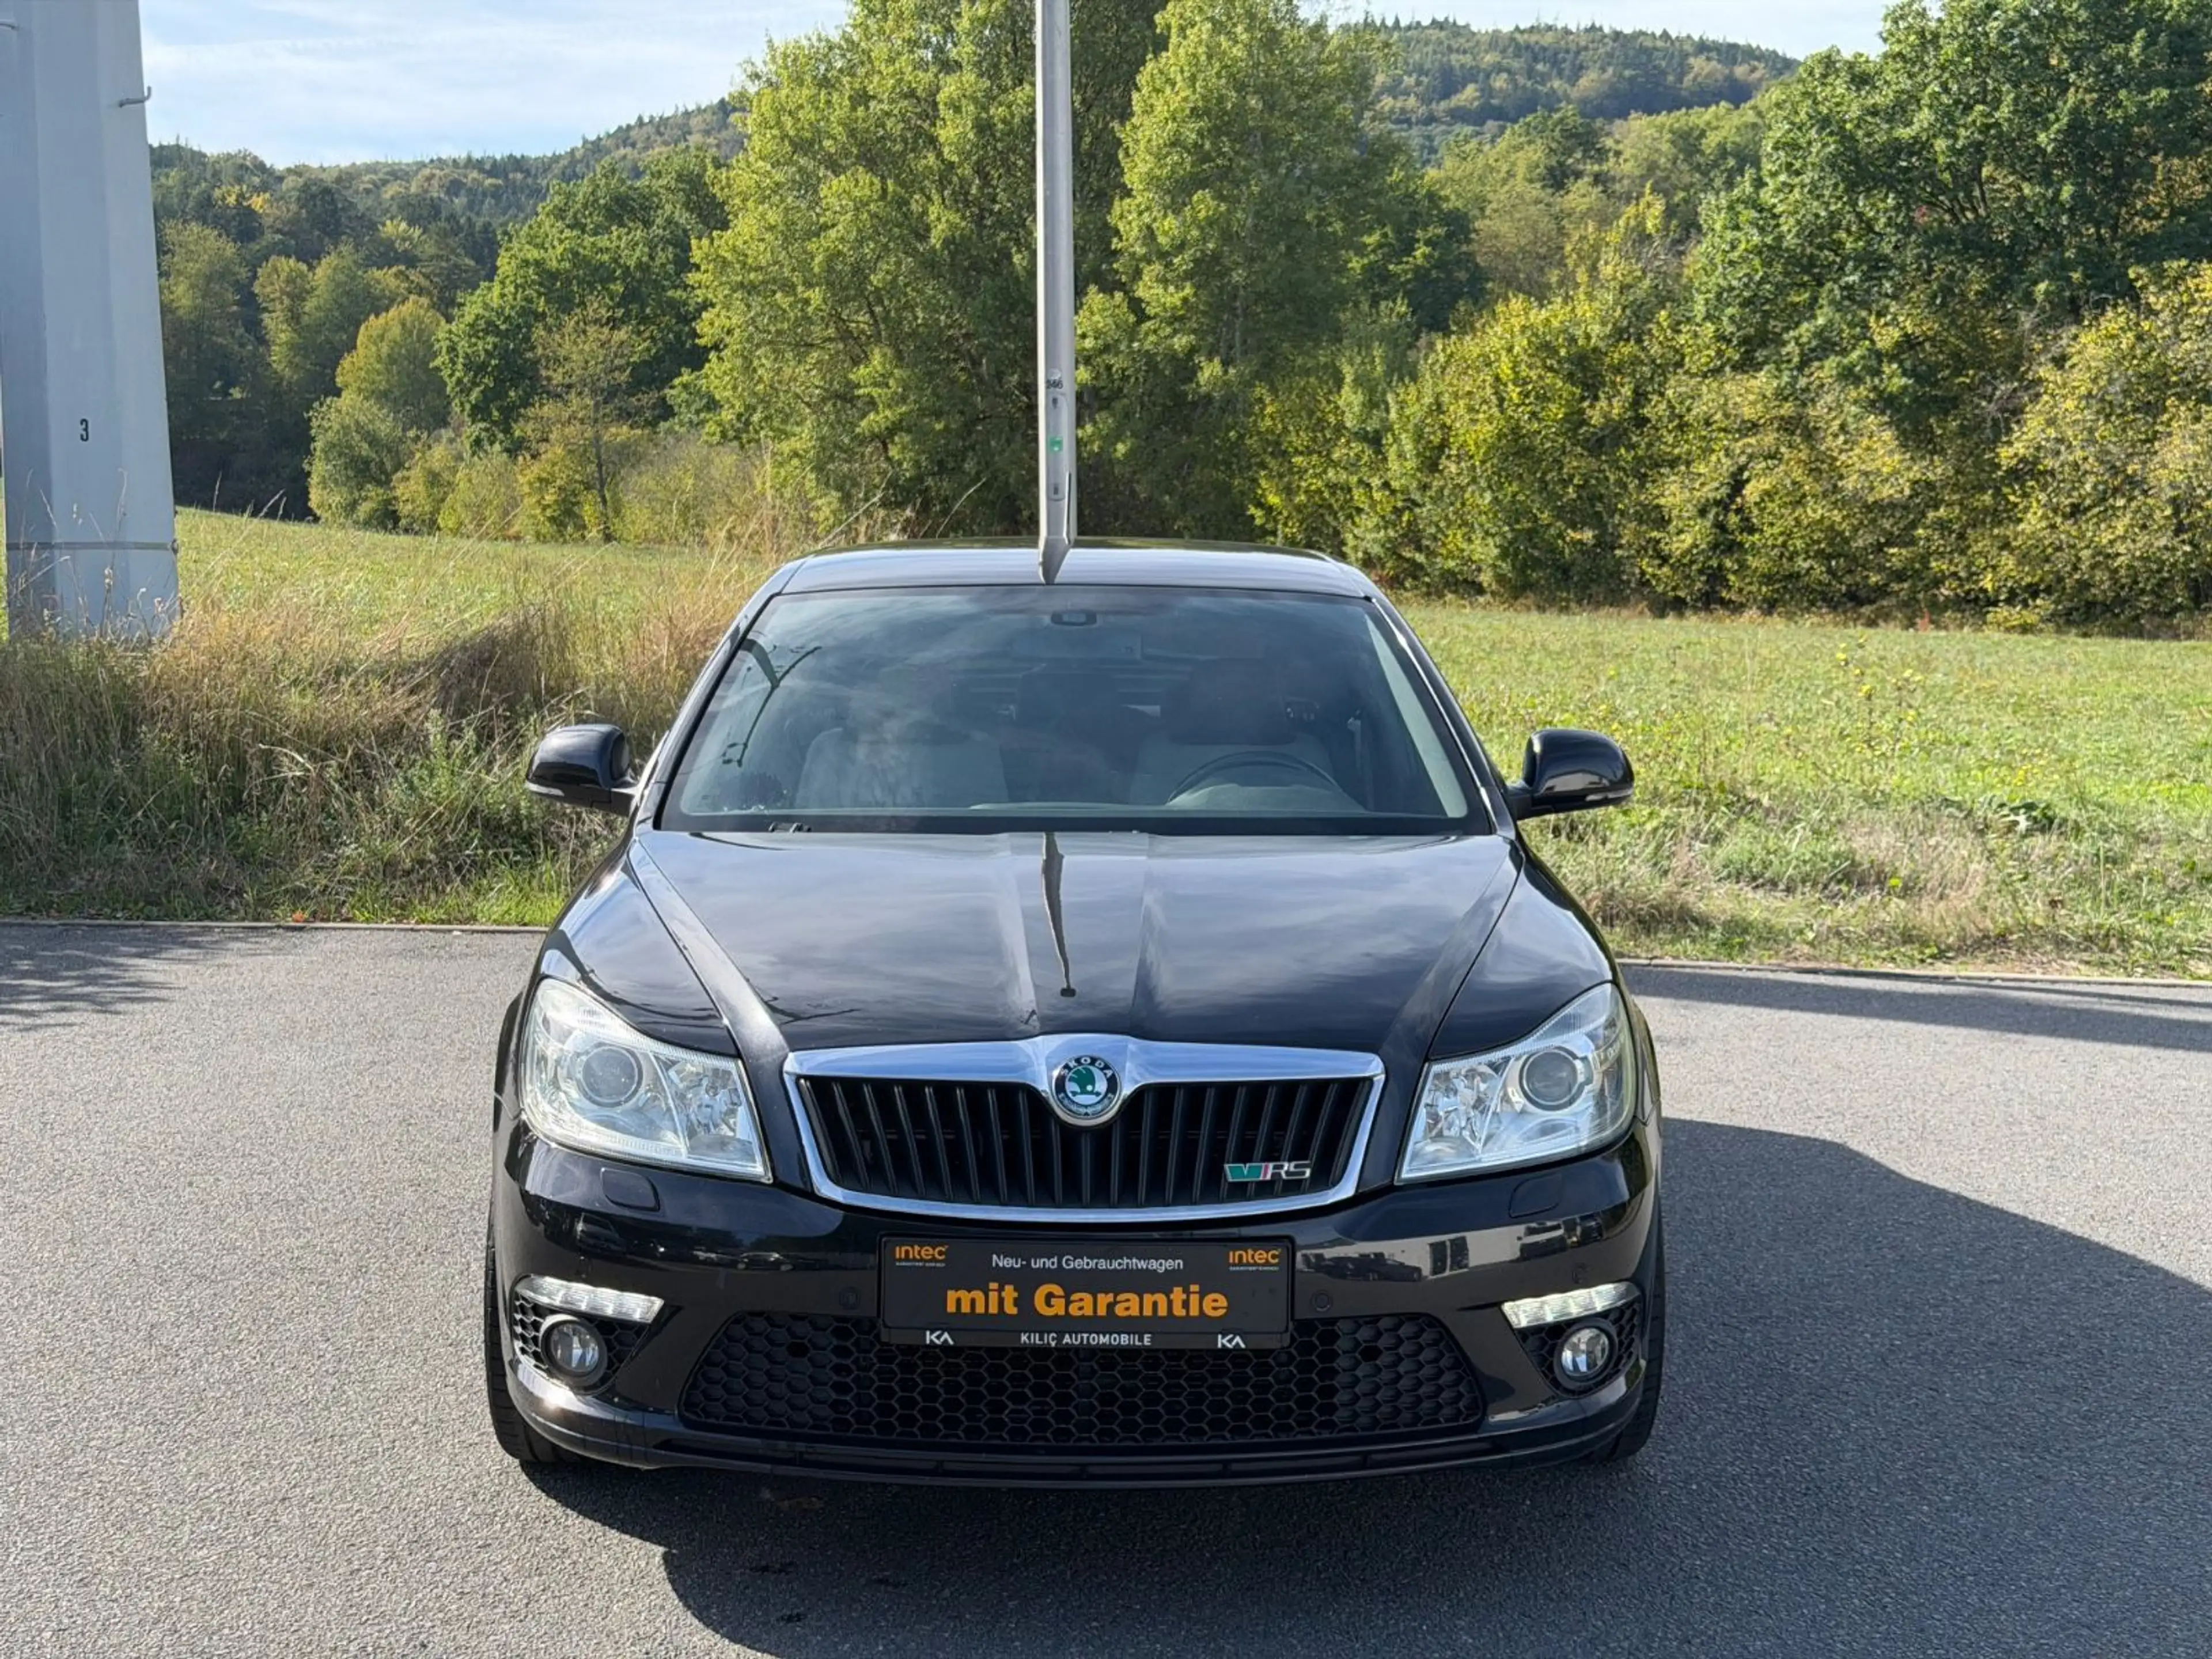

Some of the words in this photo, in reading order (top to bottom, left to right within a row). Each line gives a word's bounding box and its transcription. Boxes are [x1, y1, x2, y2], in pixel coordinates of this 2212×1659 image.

[80, 418, 89, 442] 3
[895, 1244, 946, 1260] intec
[1229, 1248, 1279, 1263] intec
[992, 1253, 1027, 1268] Neu-
[1031, 1255, 1058, 1269] und
[1062, 1255, 1184, 1273] Gebrauchtwagen
[946, 1282, 1018, 1315] mit
[1034, 1283, 1229, 1317] Garantie
[1021, 1332, 1058, 1347] KILIÇ
[1063, 1333, 1152, 1346] AUTOMOBILE
